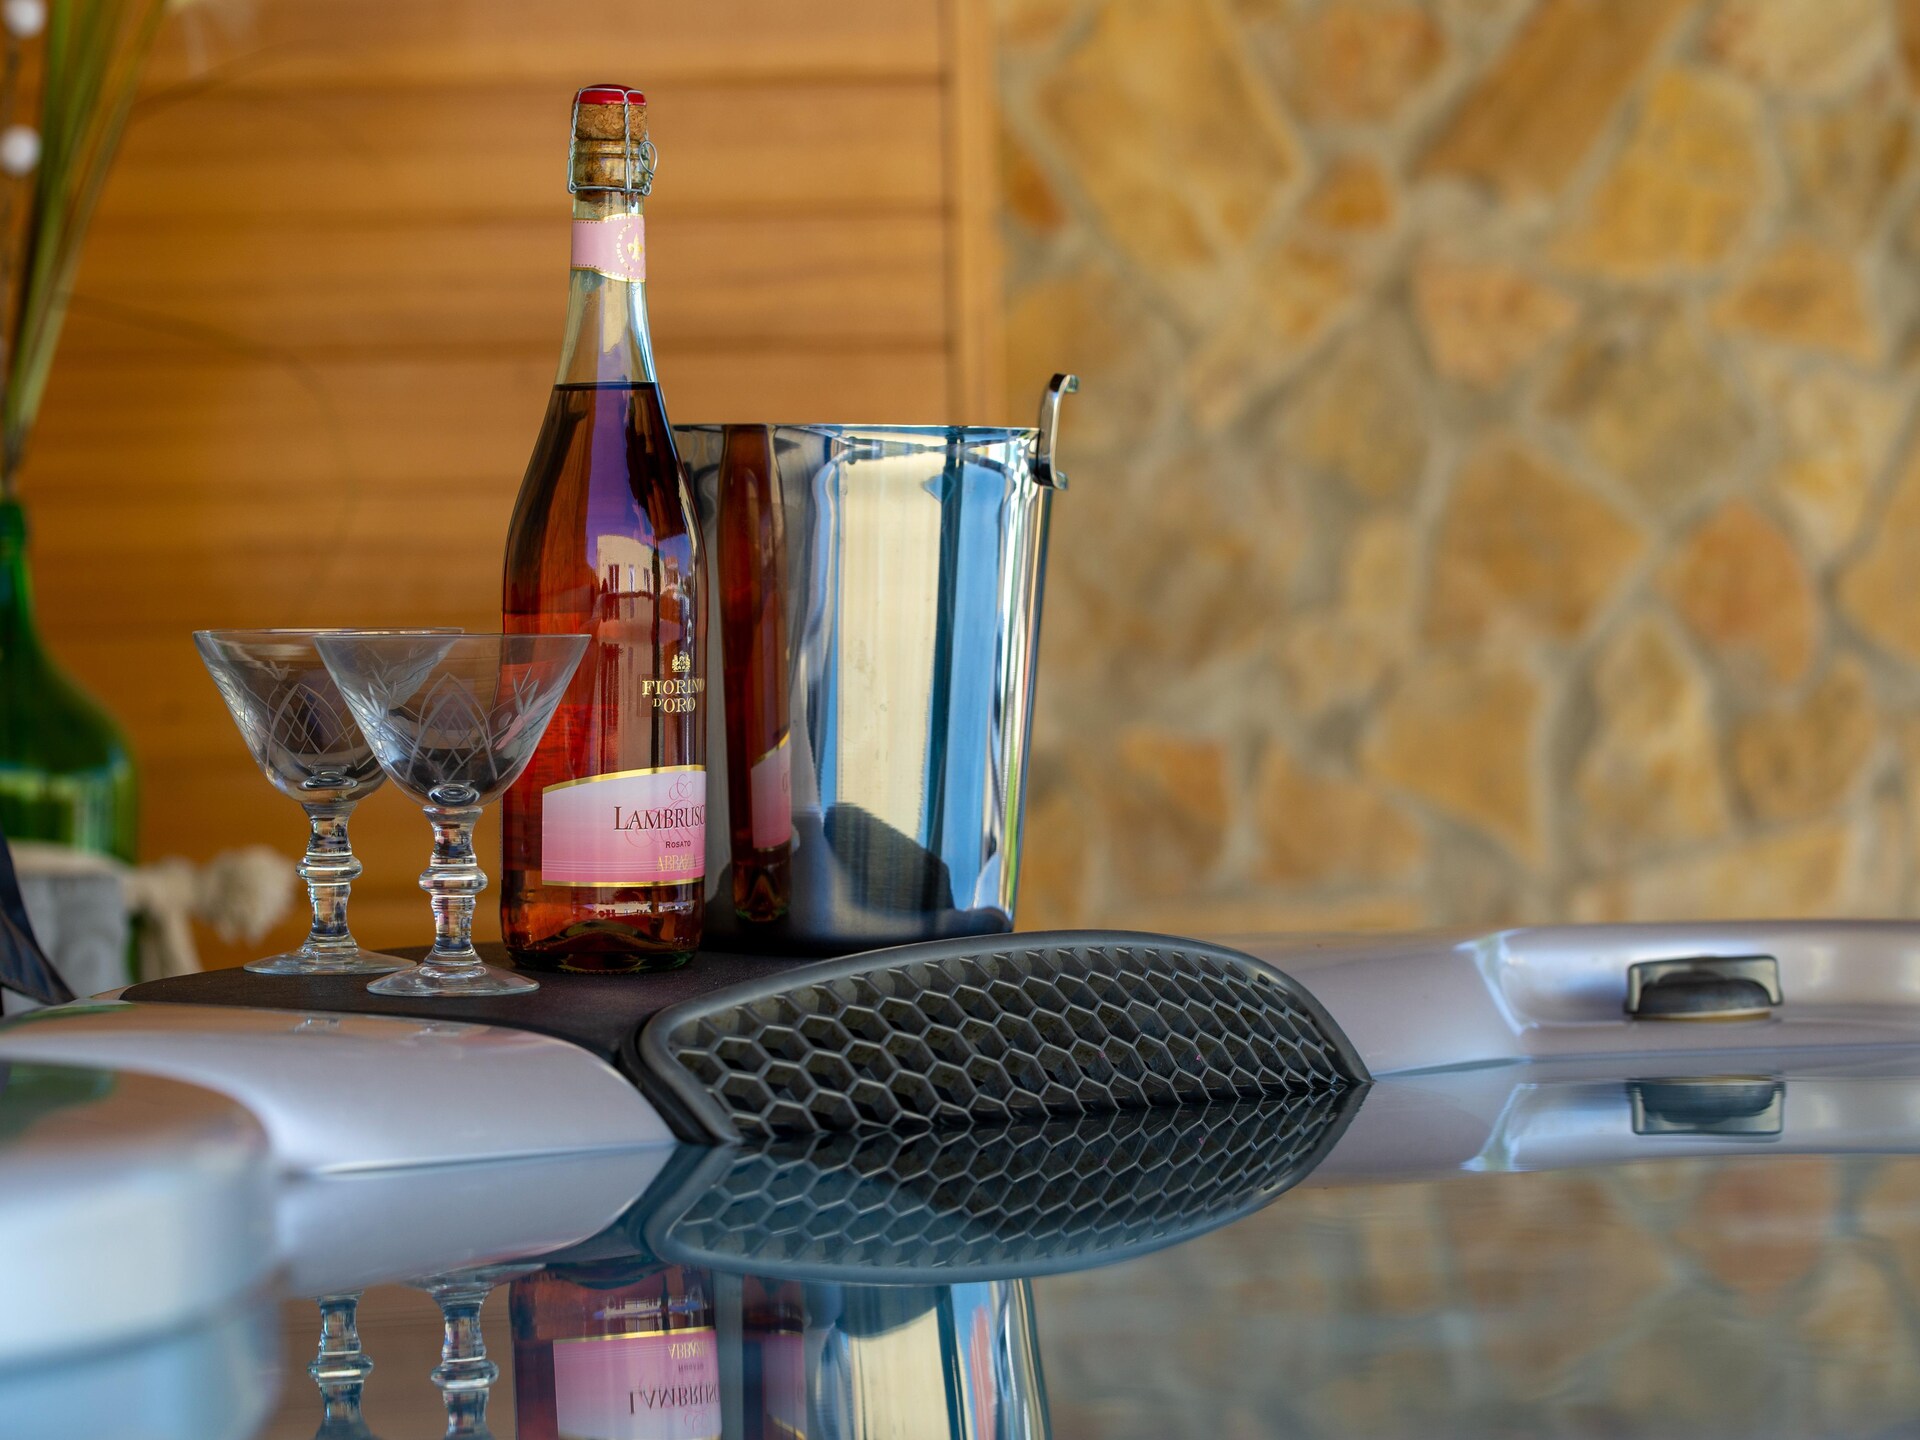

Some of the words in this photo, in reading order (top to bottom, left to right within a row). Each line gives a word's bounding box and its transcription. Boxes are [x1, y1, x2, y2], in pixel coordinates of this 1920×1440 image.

[641, 677, 705, 696] FIORINO
[653, 697, 696, 713] D'ORO
[665, 840, 691, 849] ROSATO
